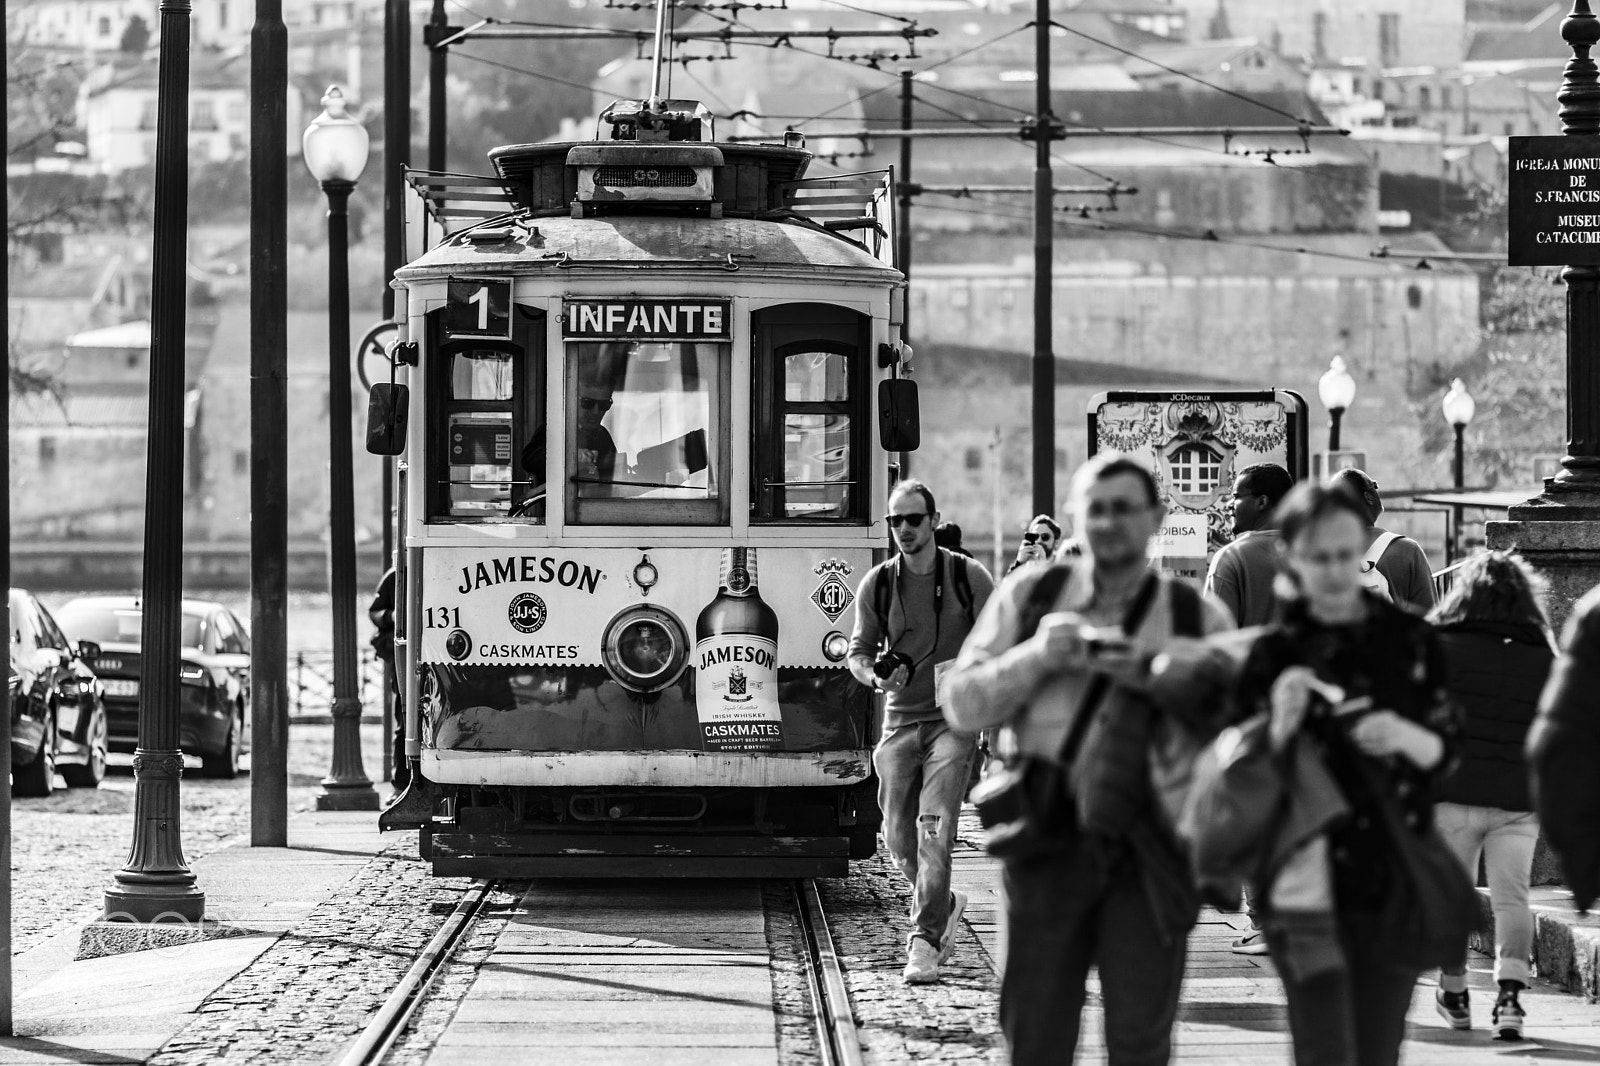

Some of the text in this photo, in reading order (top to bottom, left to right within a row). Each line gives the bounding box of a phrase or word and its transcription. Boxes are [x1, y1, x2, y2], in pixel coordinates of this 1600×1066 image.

[1515, 158, 1600, 170] IGREJA MONU
[1569, 175, 1587, 188] DE
[1557, 215, 1600, 227] MUSEU
[468, 286, 490, 330] 1
[569, 304, 723, 334] INFANTE
[1170, 393, 1211, 402] JCDecaux
[458, 556, 602, 594] JAMESON
[1174, 569, 1197, 578] LIKE
[424, 606, 463, 629] 131
[479, 644, 578, 659] CASKMATES
[701, 646, 774, 670] JAMESON
[705, 724, 780, 737] CASKMATES
